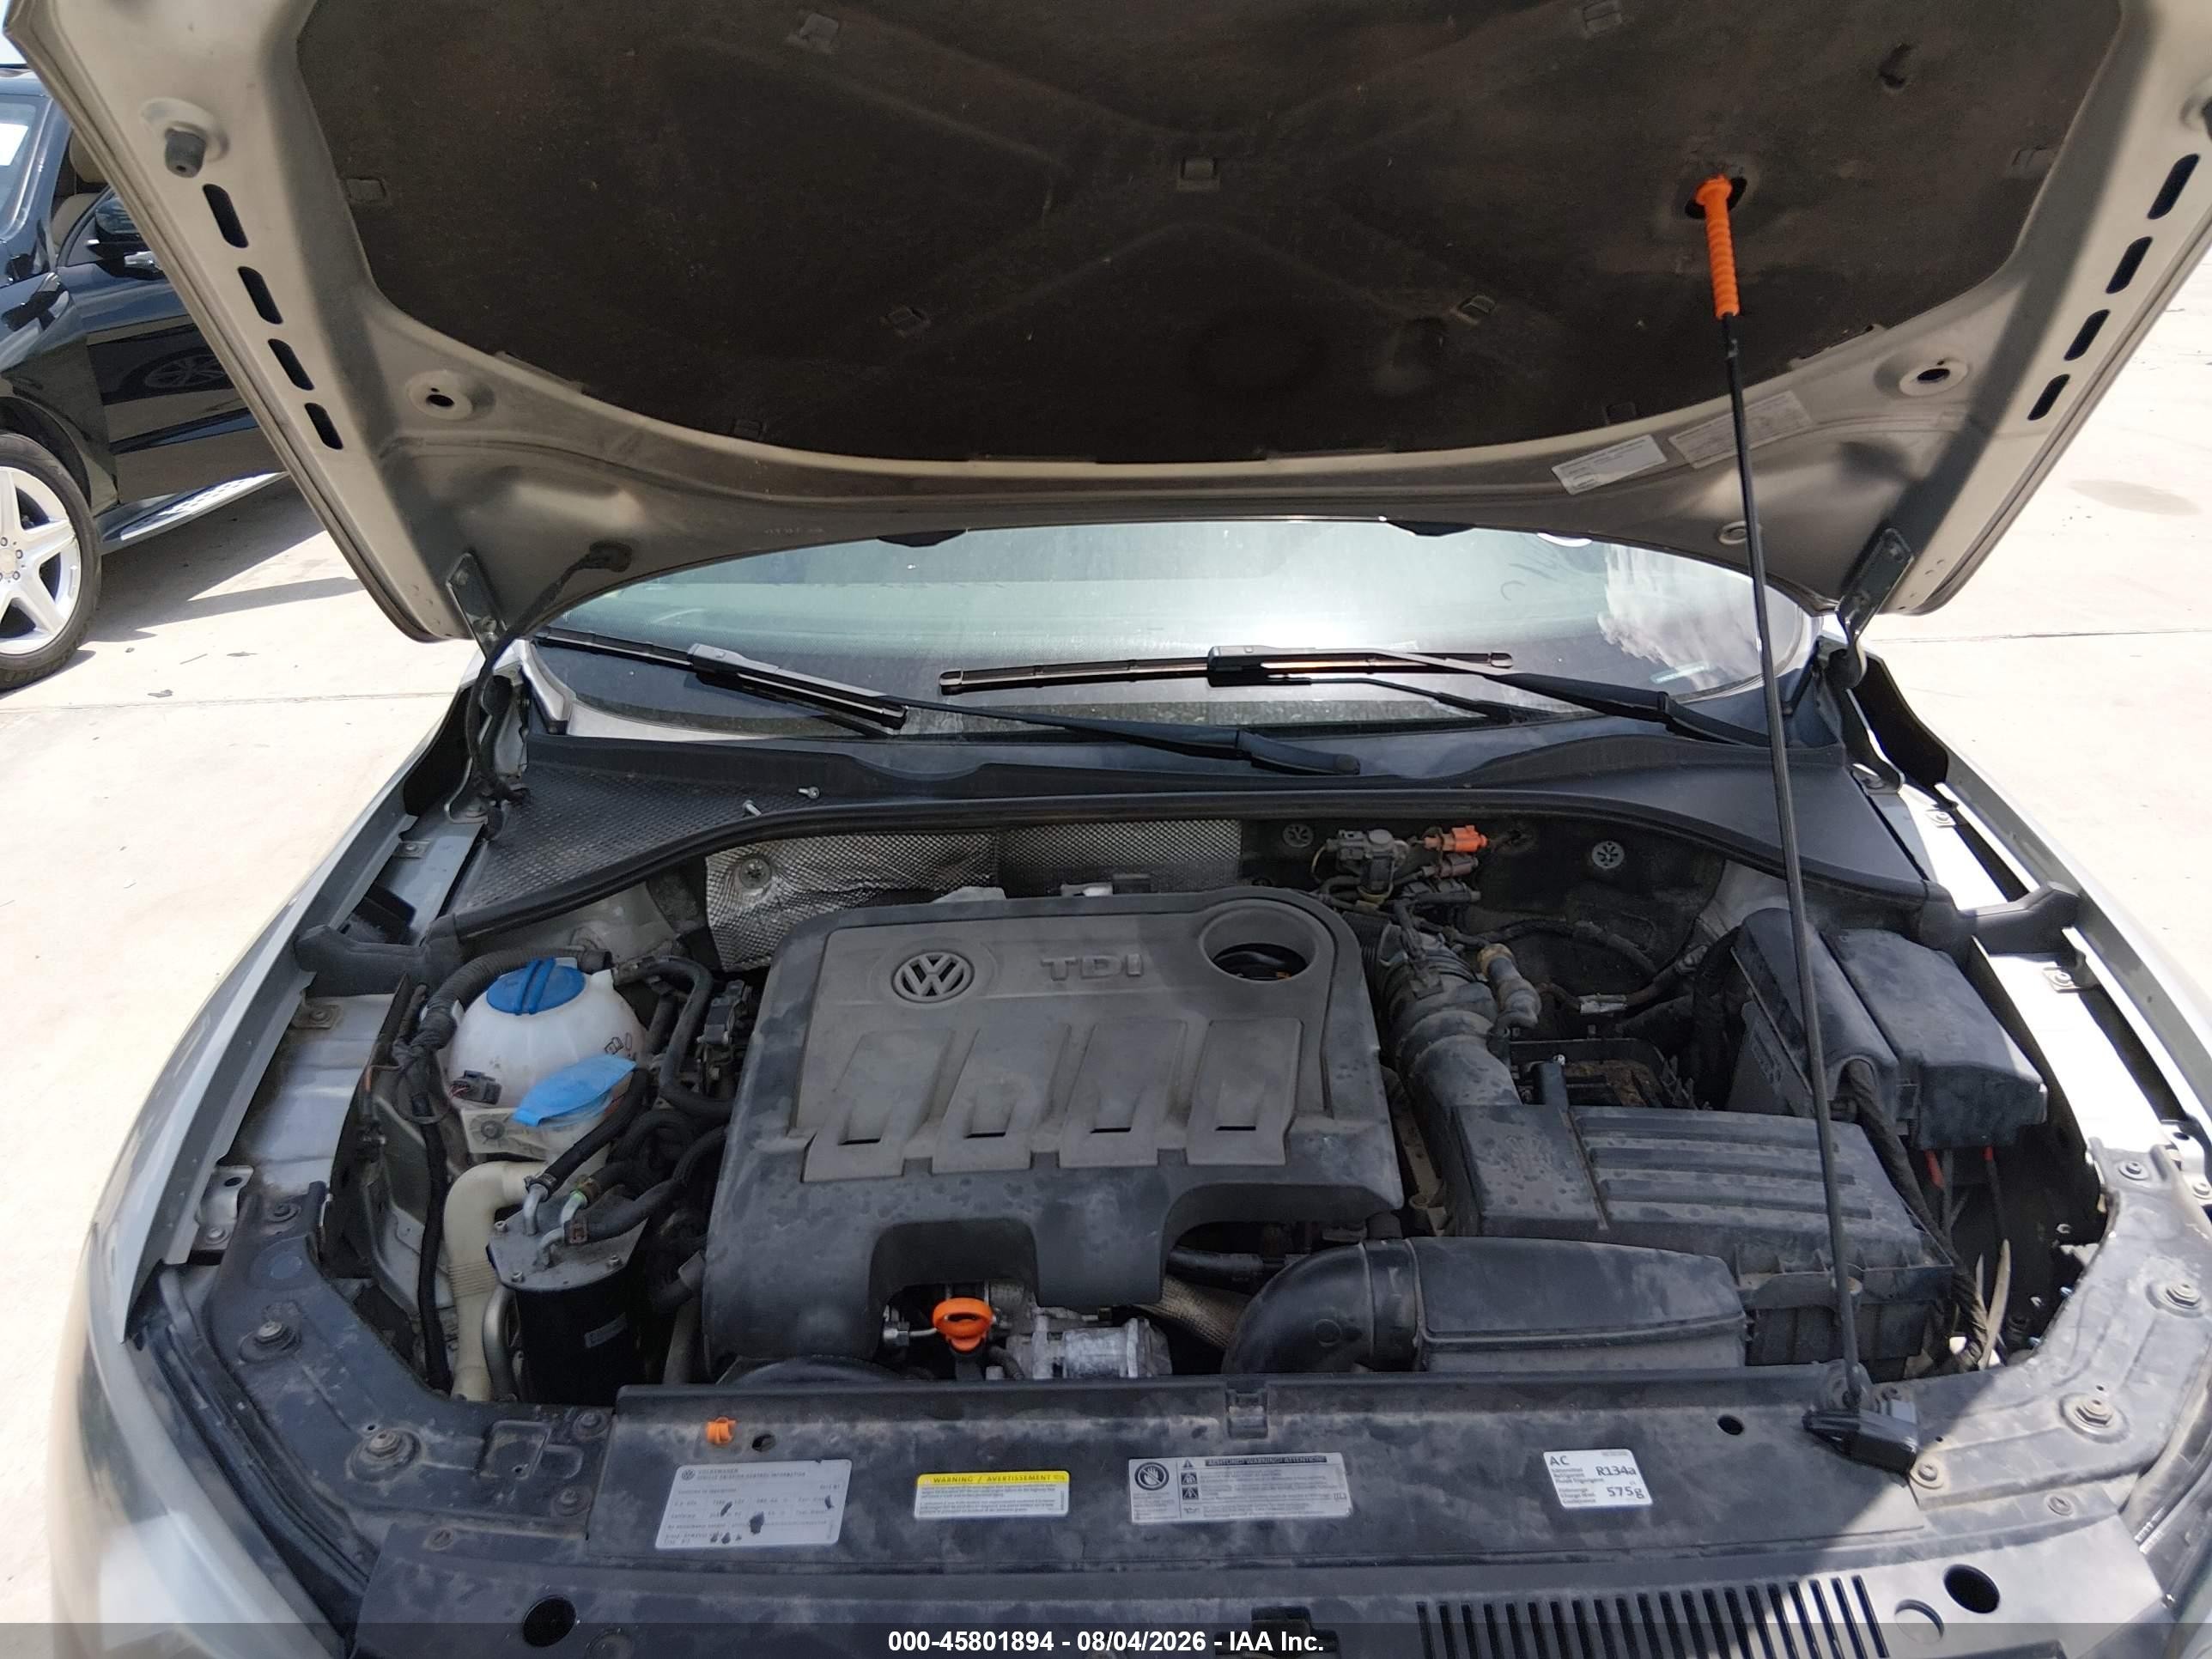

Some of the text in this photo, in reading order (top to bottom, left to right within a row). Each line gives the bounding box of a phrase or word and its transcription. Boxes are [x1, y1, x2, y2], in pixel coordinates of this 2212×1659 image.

[1041, 953, 1144, 981] TDI
[1246, 1455, 1283, 1464] WARNING!
[1550, 1455, 1570, 1466] AC
[1595, 1466, 1637, 1476] R134a
[933, 1475, 973, 1484] WARNING
